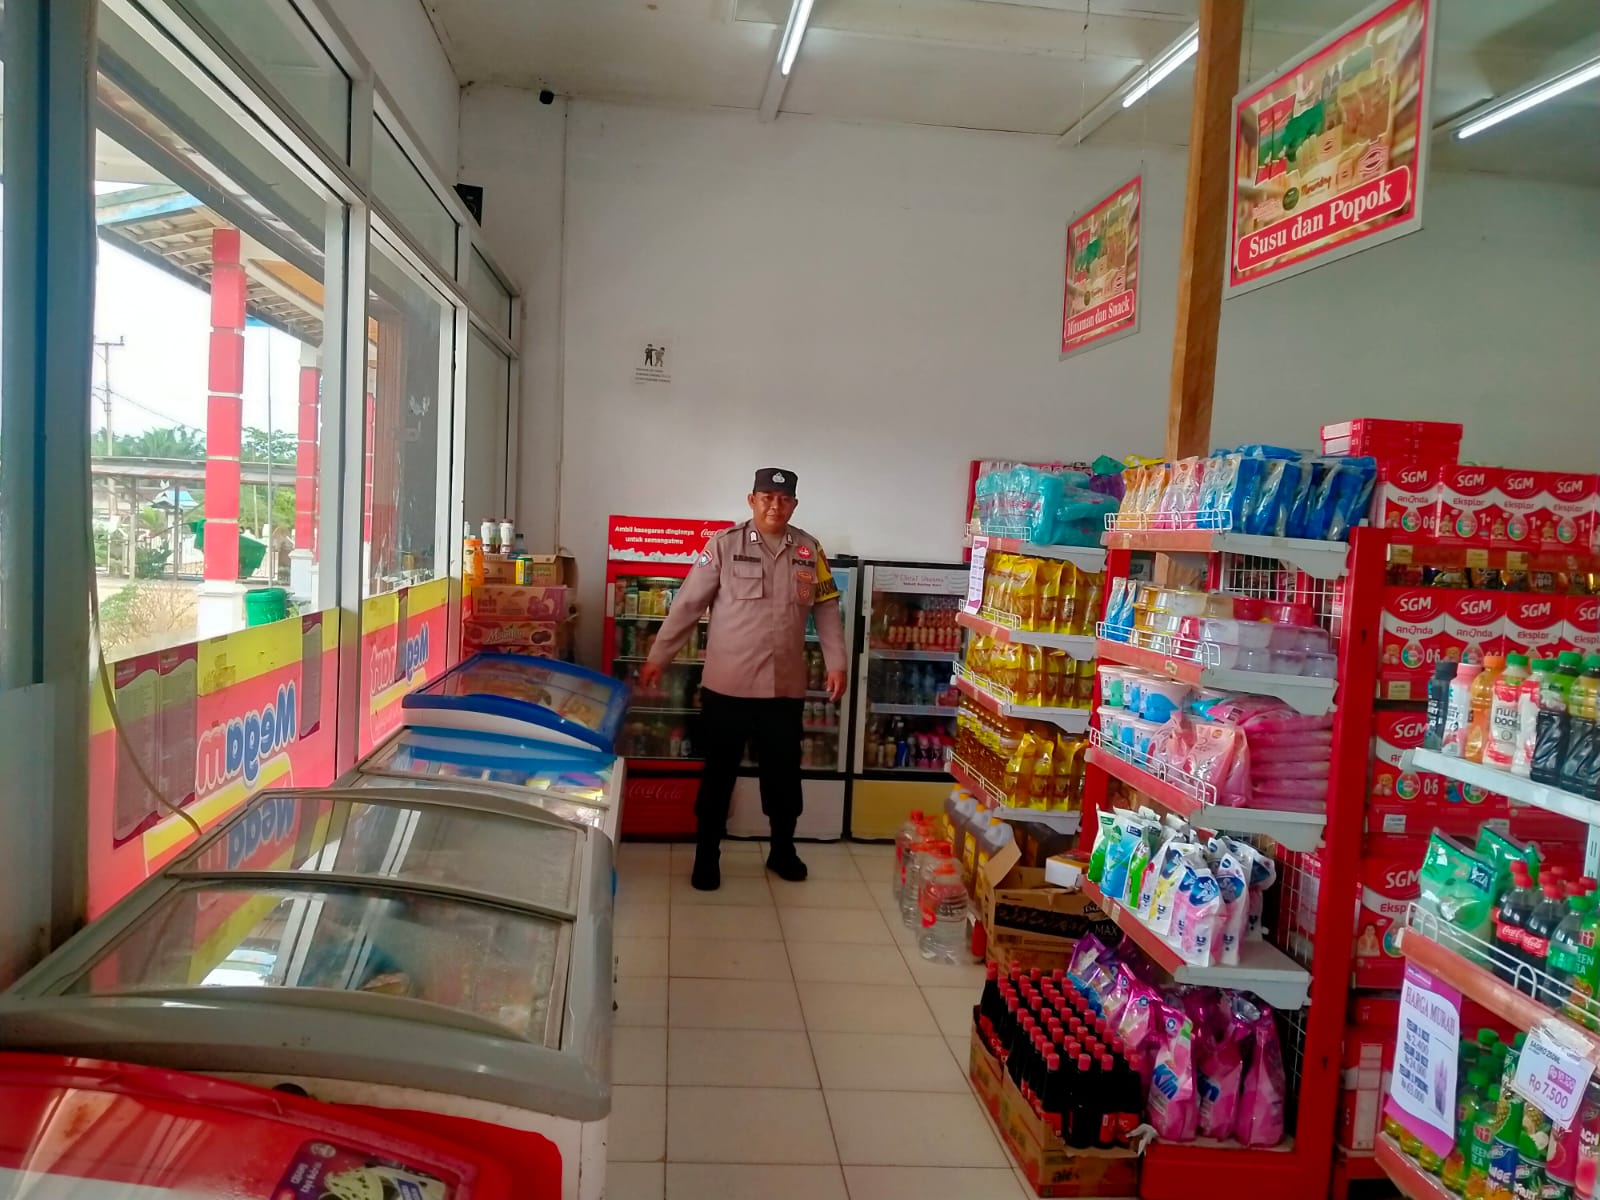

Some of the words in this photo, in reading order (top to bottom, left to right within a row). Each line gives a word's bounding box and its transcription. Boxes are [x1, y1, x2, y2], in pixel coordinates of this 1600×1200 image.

[1249, 229, 1287, 259] Susu
[1291, 213, 1323, 240] dan
[1329, 180, 1392, 227] Popok
[1095, 307, 1107, 325] dan
[1108, 296, 1130, 319] Snack
[1401, 470, 1428, 484] SGM
[1457, 473, 1485, 487] SGM
[1507, 477, 1534, 491] SGM
[1556, 480, 1583, 494] SGM
[1453, 497, 1485, 506] Eksplor
[1504, 501, 1535, 510] Eksplor
[1553, 504, 1584, 513] Eksplor
[1400, 596, 1431, 612] SGM
[1460, 599, 1492, 615] SGM
[1520, 602, 1551, 618] SGM
[1517, 631, 1549, 641] Eksplor
[1394, 722, 1430, 738] SGM
[1385, 869, 1421, 889] SGM
[1405, 986, 1429, 1018] HARGA
[1430, 1003, 1456, 1036] MURAH
[1529, 1073, 1541, 1092] Rp
[1542, 1081, 1568, 1109] 7.500
